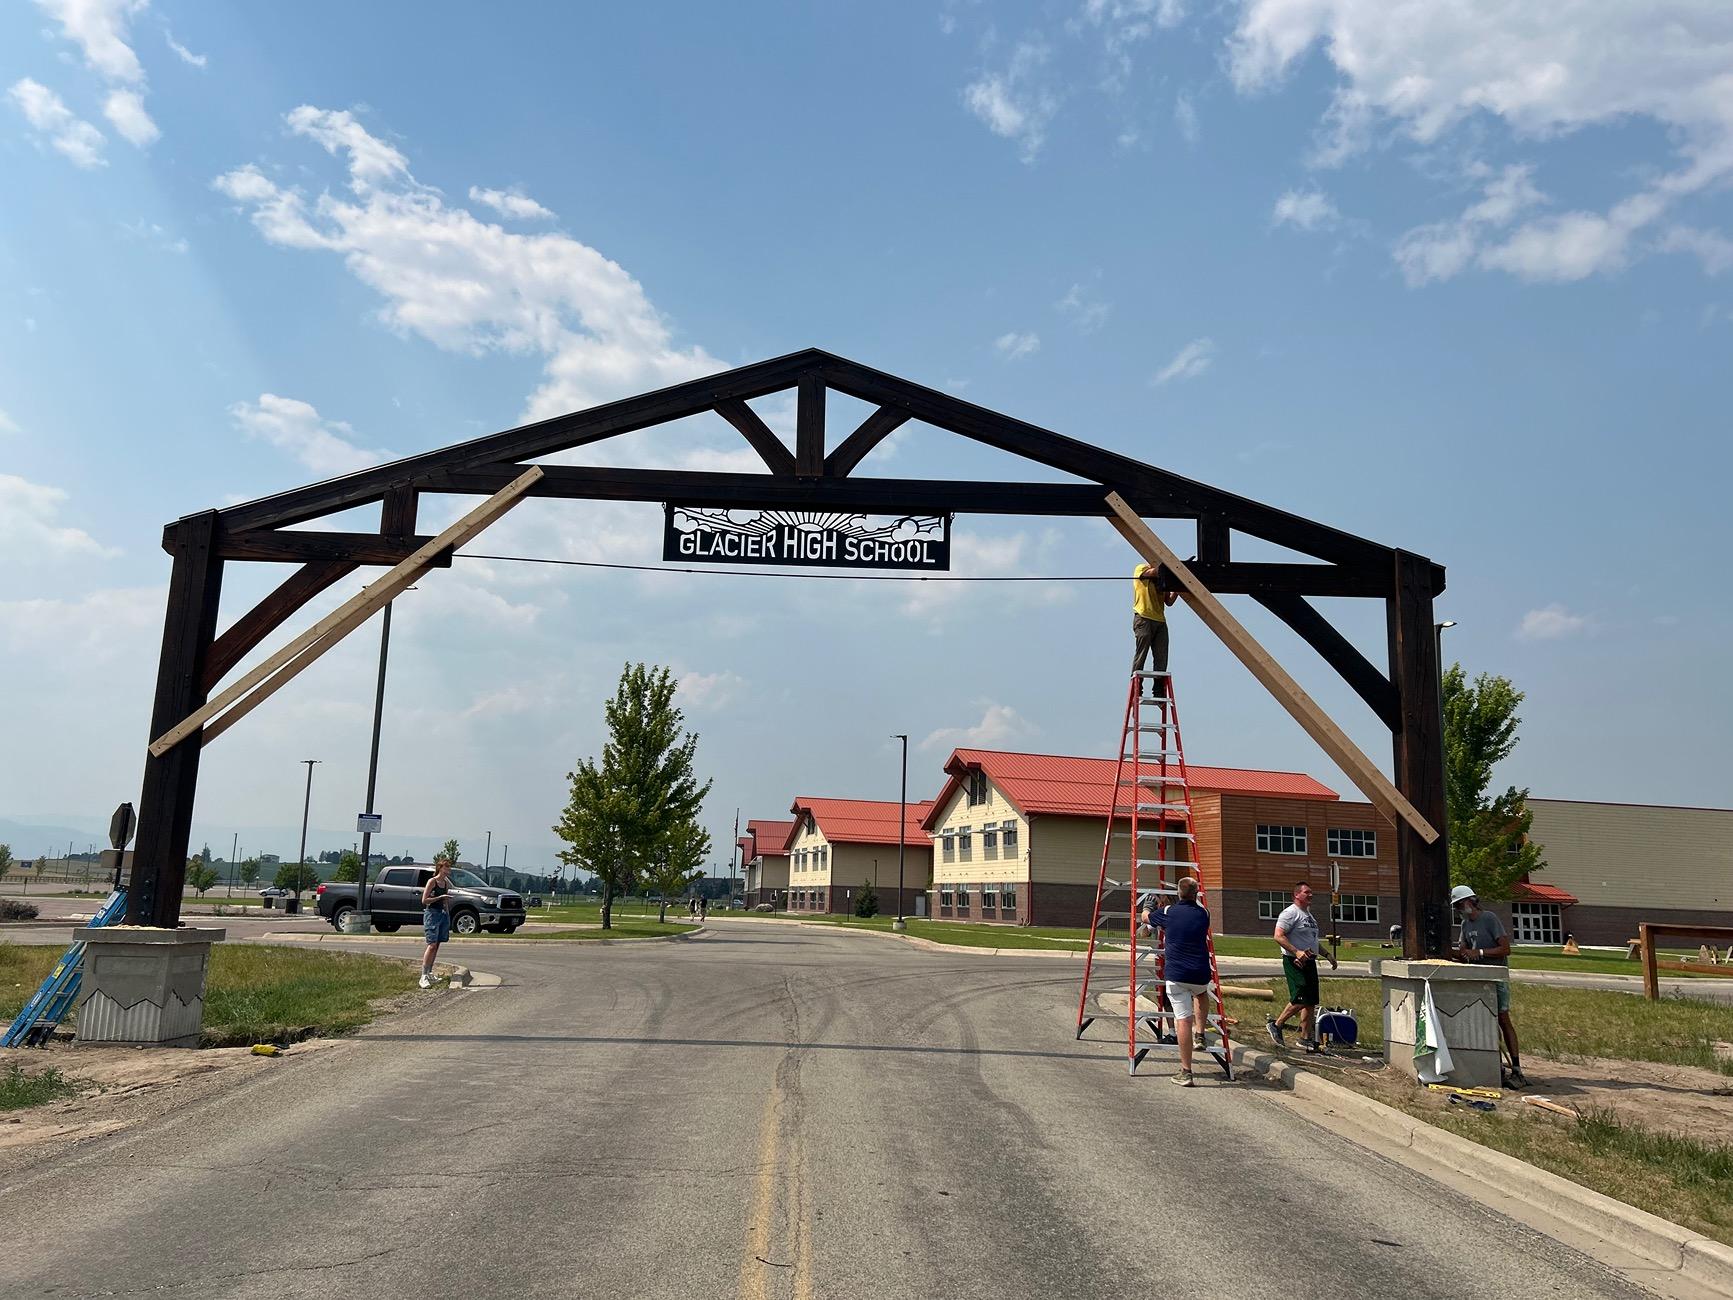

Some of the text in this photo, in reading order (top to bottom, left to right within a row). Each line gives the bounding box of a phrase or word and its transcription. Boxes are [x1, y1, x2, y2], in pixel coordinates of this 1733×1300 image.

[679, 526, 936, 564] GLACIER HIGH SCHOOL
